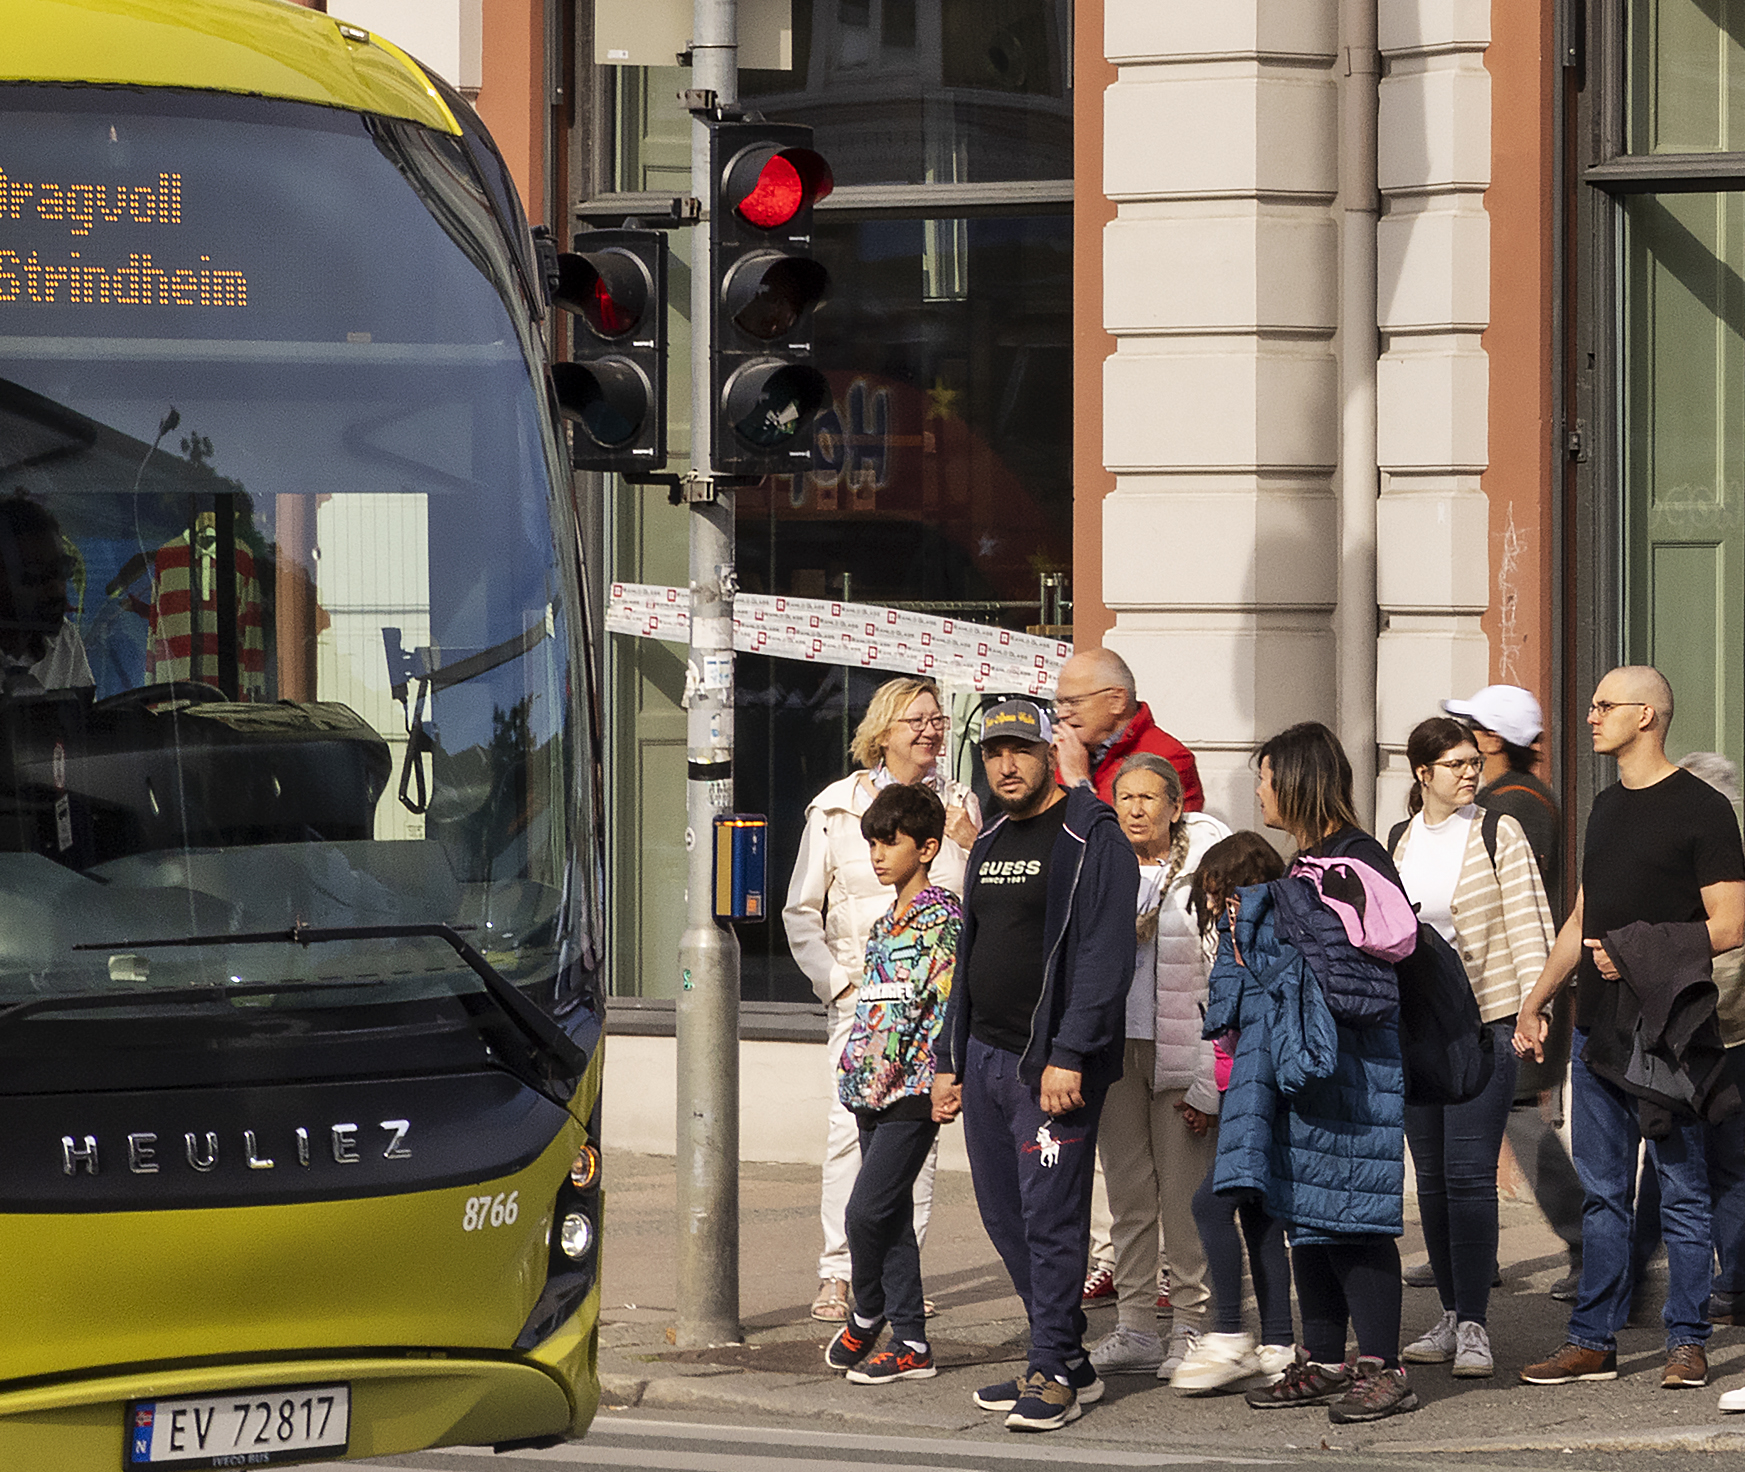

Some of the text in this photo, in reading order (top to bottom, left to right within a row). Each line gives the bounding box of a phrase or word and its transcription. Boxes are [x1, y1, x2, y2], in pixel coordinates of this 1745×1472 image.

[979, 860, 1042, 876] GUESS
[61, 1118, 413, 1176] HEULIEZ
[462, 1190, 520, 1232] 8766
[134, 1395, 335, 1454] N EV 72817
[212, 1451, 271, 1467] IVECO BUS
